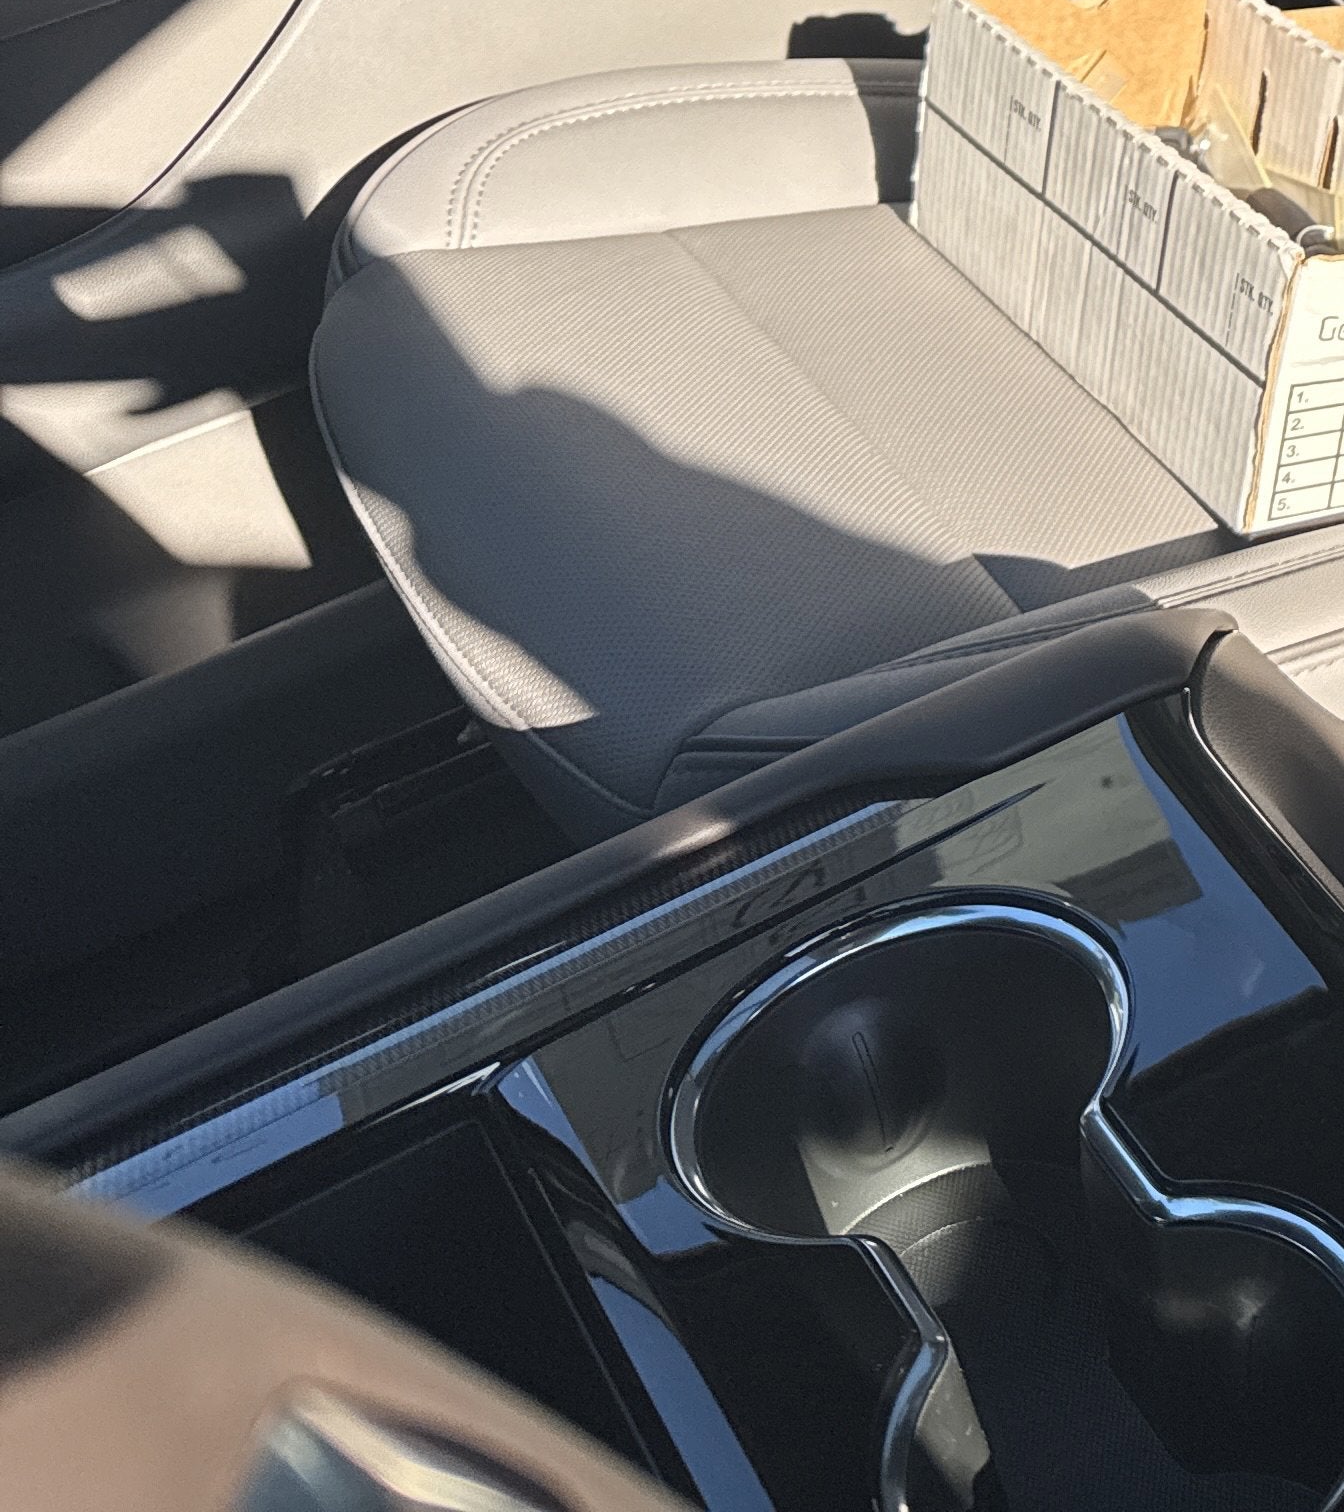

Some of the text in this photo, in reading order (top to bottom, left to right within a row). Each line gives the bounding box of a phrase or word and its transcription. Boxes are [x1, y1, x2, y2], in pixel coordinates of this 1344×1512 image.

[1296, 391, 1309, 404] 1.
[1290, 418, 1304, 432] 2.
[1286, 444, 1300, 458] 3.
[1282, 472, 1296, 484] 4.
[1277, 497, 1291, 511] 5.
